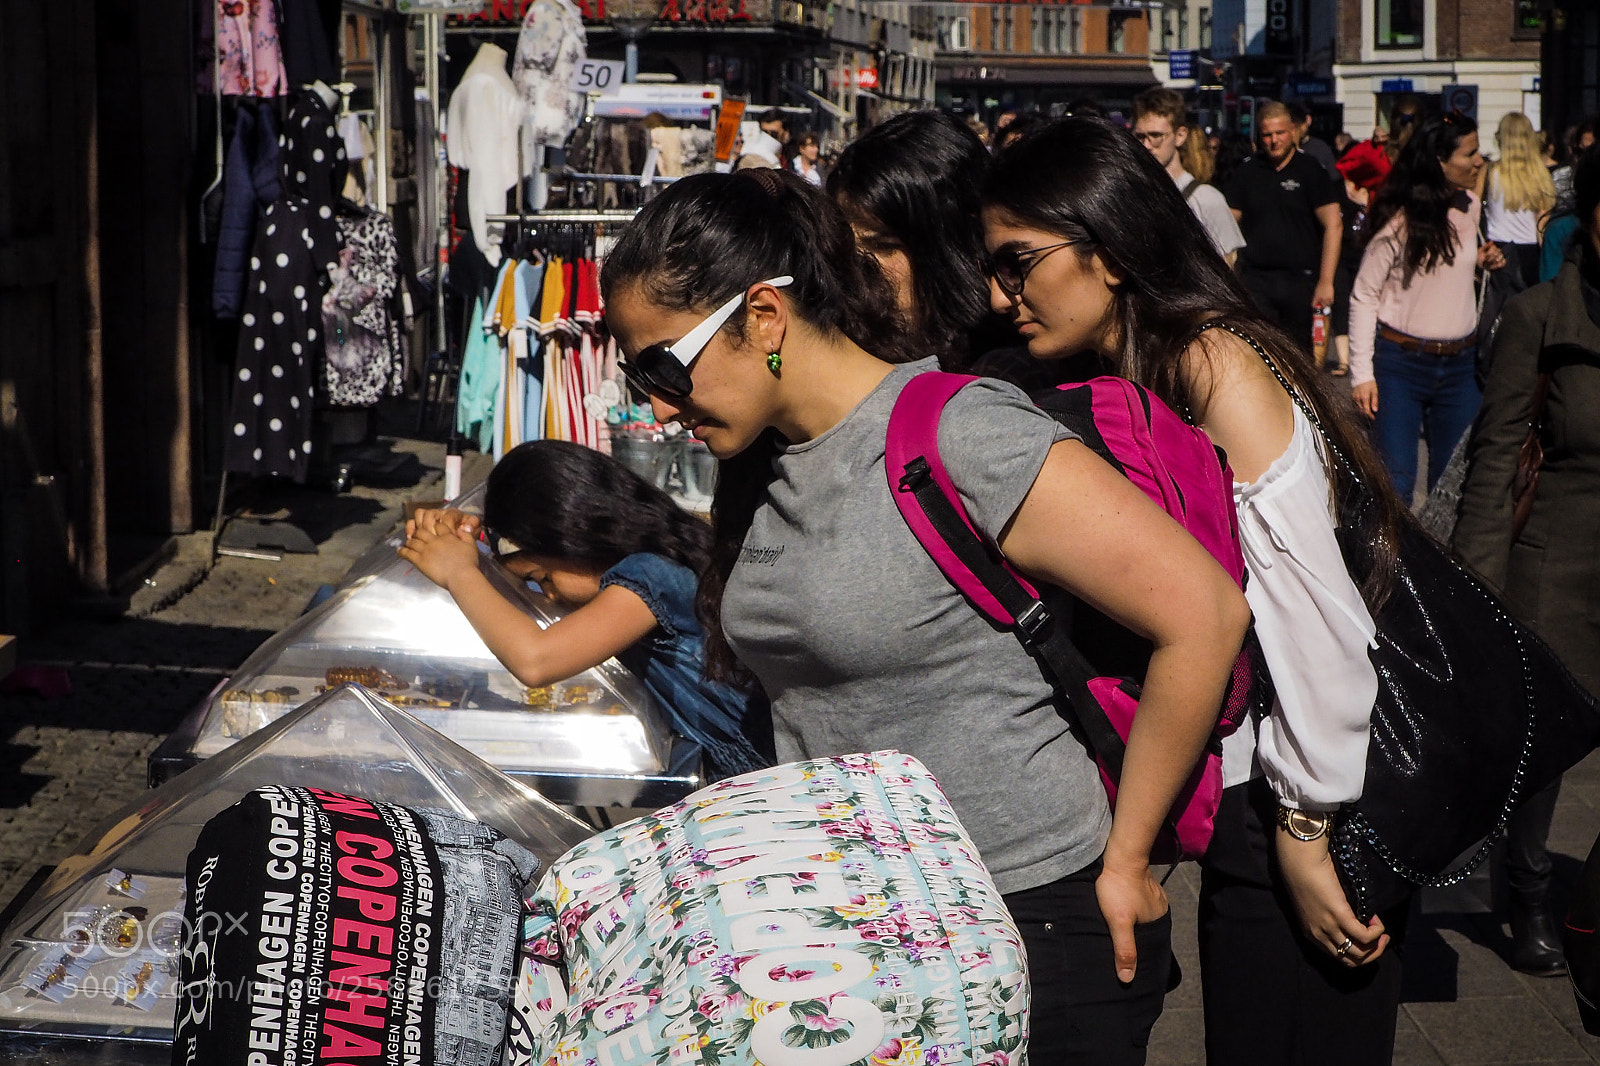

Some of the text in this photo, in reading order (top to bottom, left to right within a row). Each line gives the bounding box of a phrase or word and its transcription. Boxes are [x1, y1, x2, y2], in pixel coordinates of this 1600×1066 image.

[578, 63, 611, 88] 50
[192, 854, 219, 935] ROBIN
[291, 874, 314, 973] COPENHAGEN
[307, 841, 331, 1004] THECITYOFCOPENHAGEN
[320, 830, 399, 1066] COPENHA
[390, 856, 414, 1018] THECITYOFCOPENHAGEN
[403, 923, 431, 1066] COPENHAGEN
